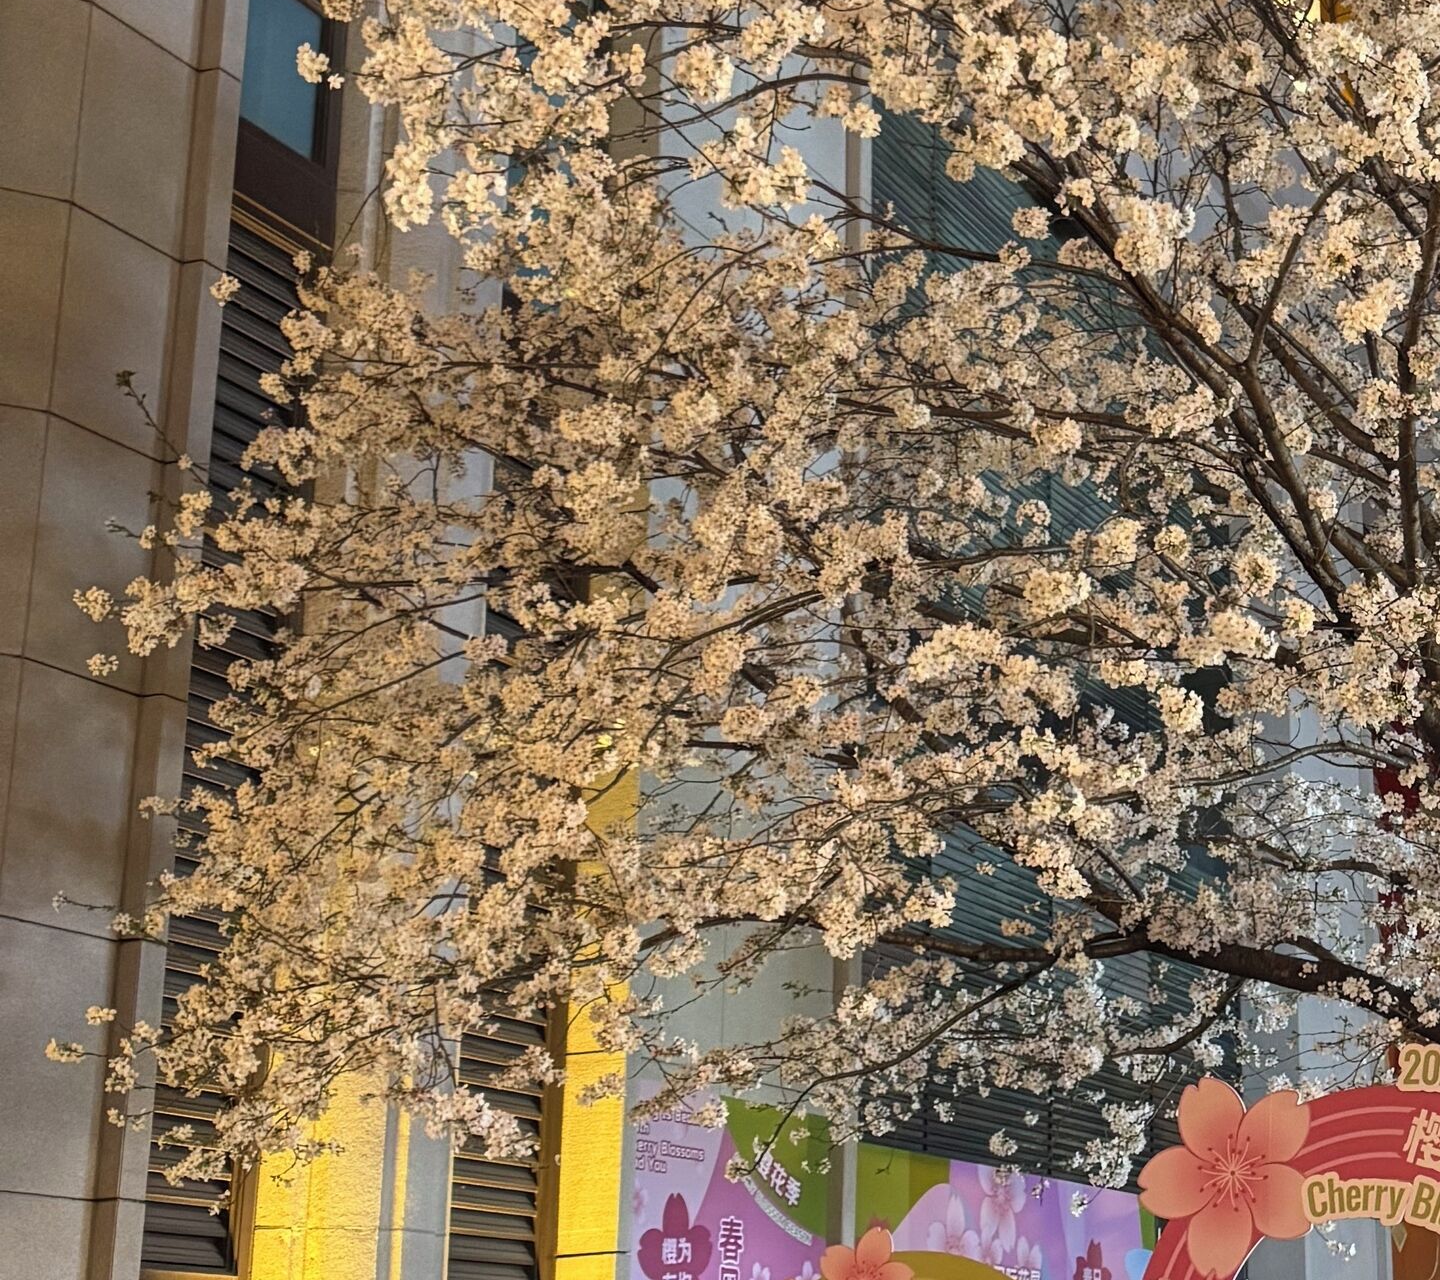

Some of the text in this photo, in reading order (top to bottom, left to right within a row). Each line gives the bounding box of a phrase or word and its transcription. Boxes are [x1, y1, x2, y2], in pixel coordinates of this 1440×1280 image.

[661, 1141, 704, 1161] Blossoms
[1307, 1178, 1405, 1219] Cherry
[662, 1238, 691, 1264] 樱为
